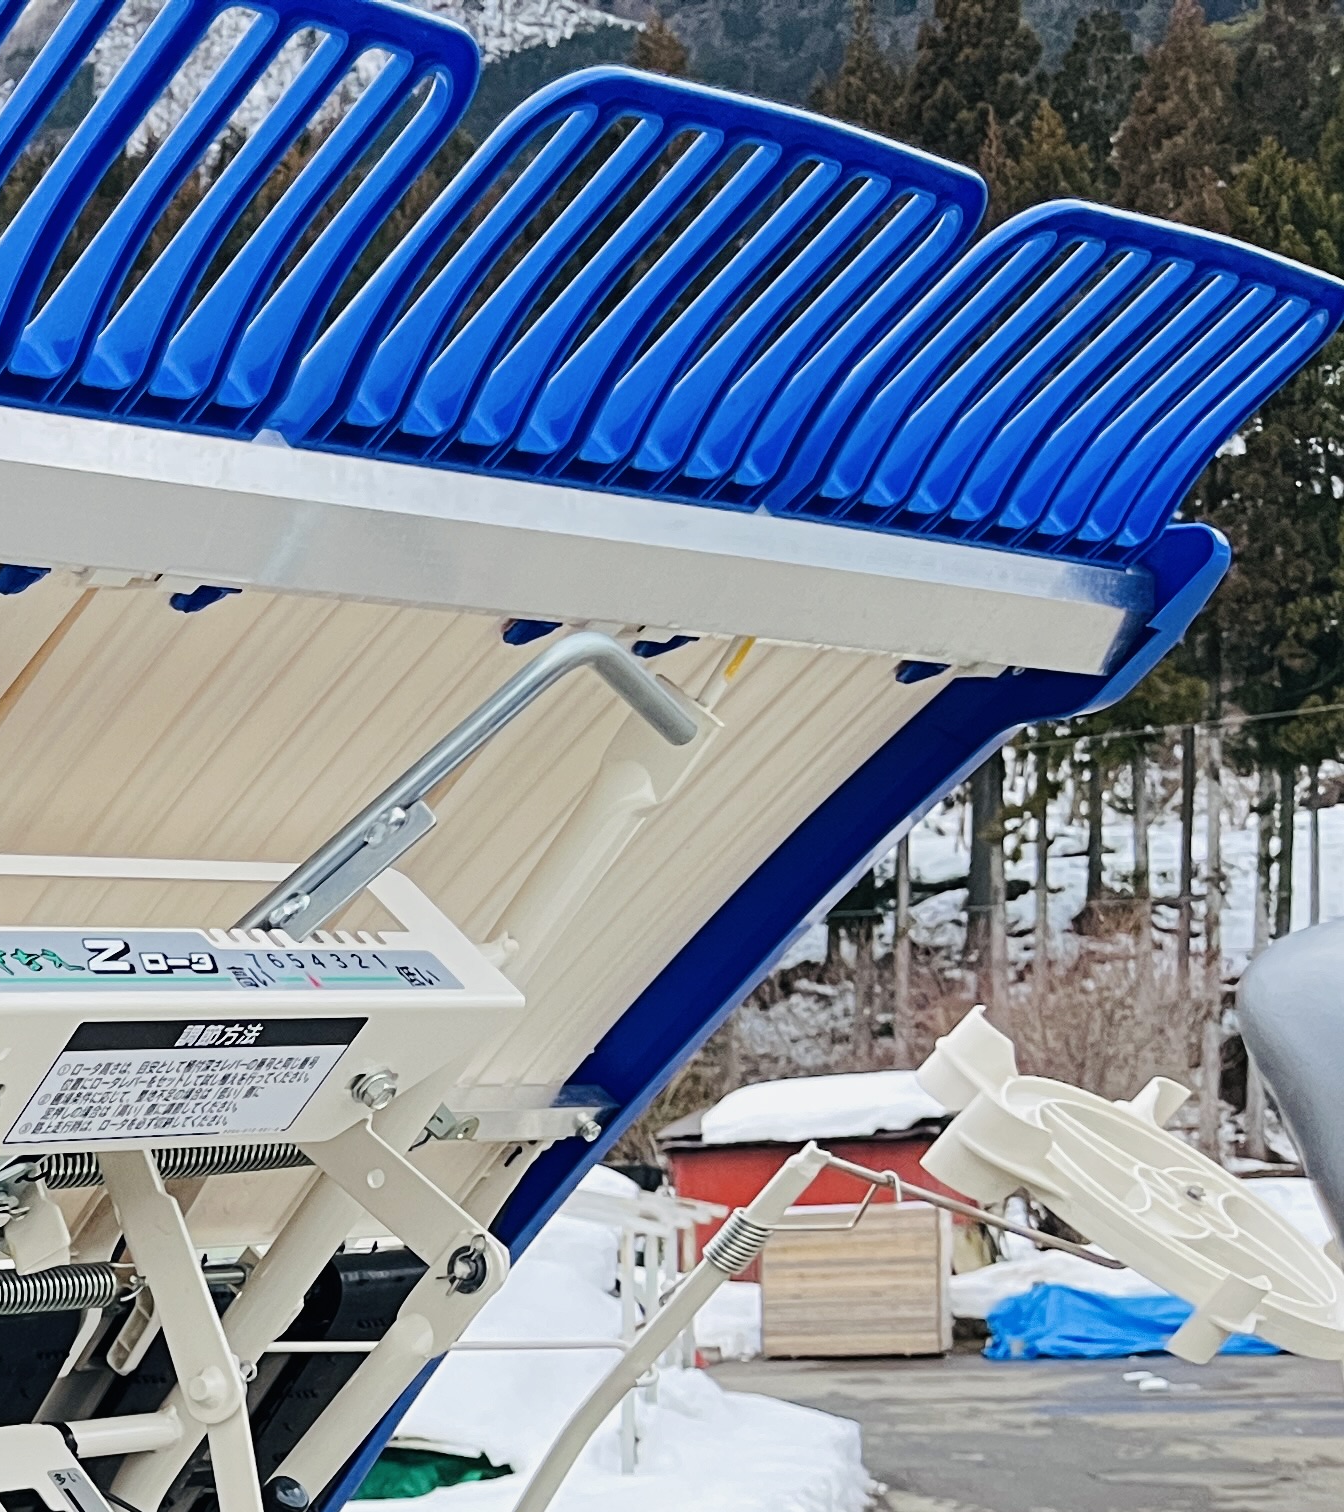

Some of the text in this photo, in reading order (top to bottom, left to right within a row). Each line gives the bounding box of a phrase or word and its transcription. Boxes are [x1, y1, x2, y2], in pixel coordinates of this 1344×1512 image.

[244, 953, 387, 969] 7 6 5 4 3 2 1
[227, 966, 276, 989] 高い
[395, 966, 441, 988] 低い
[174, 1024, 264, 1047] 調節方法
